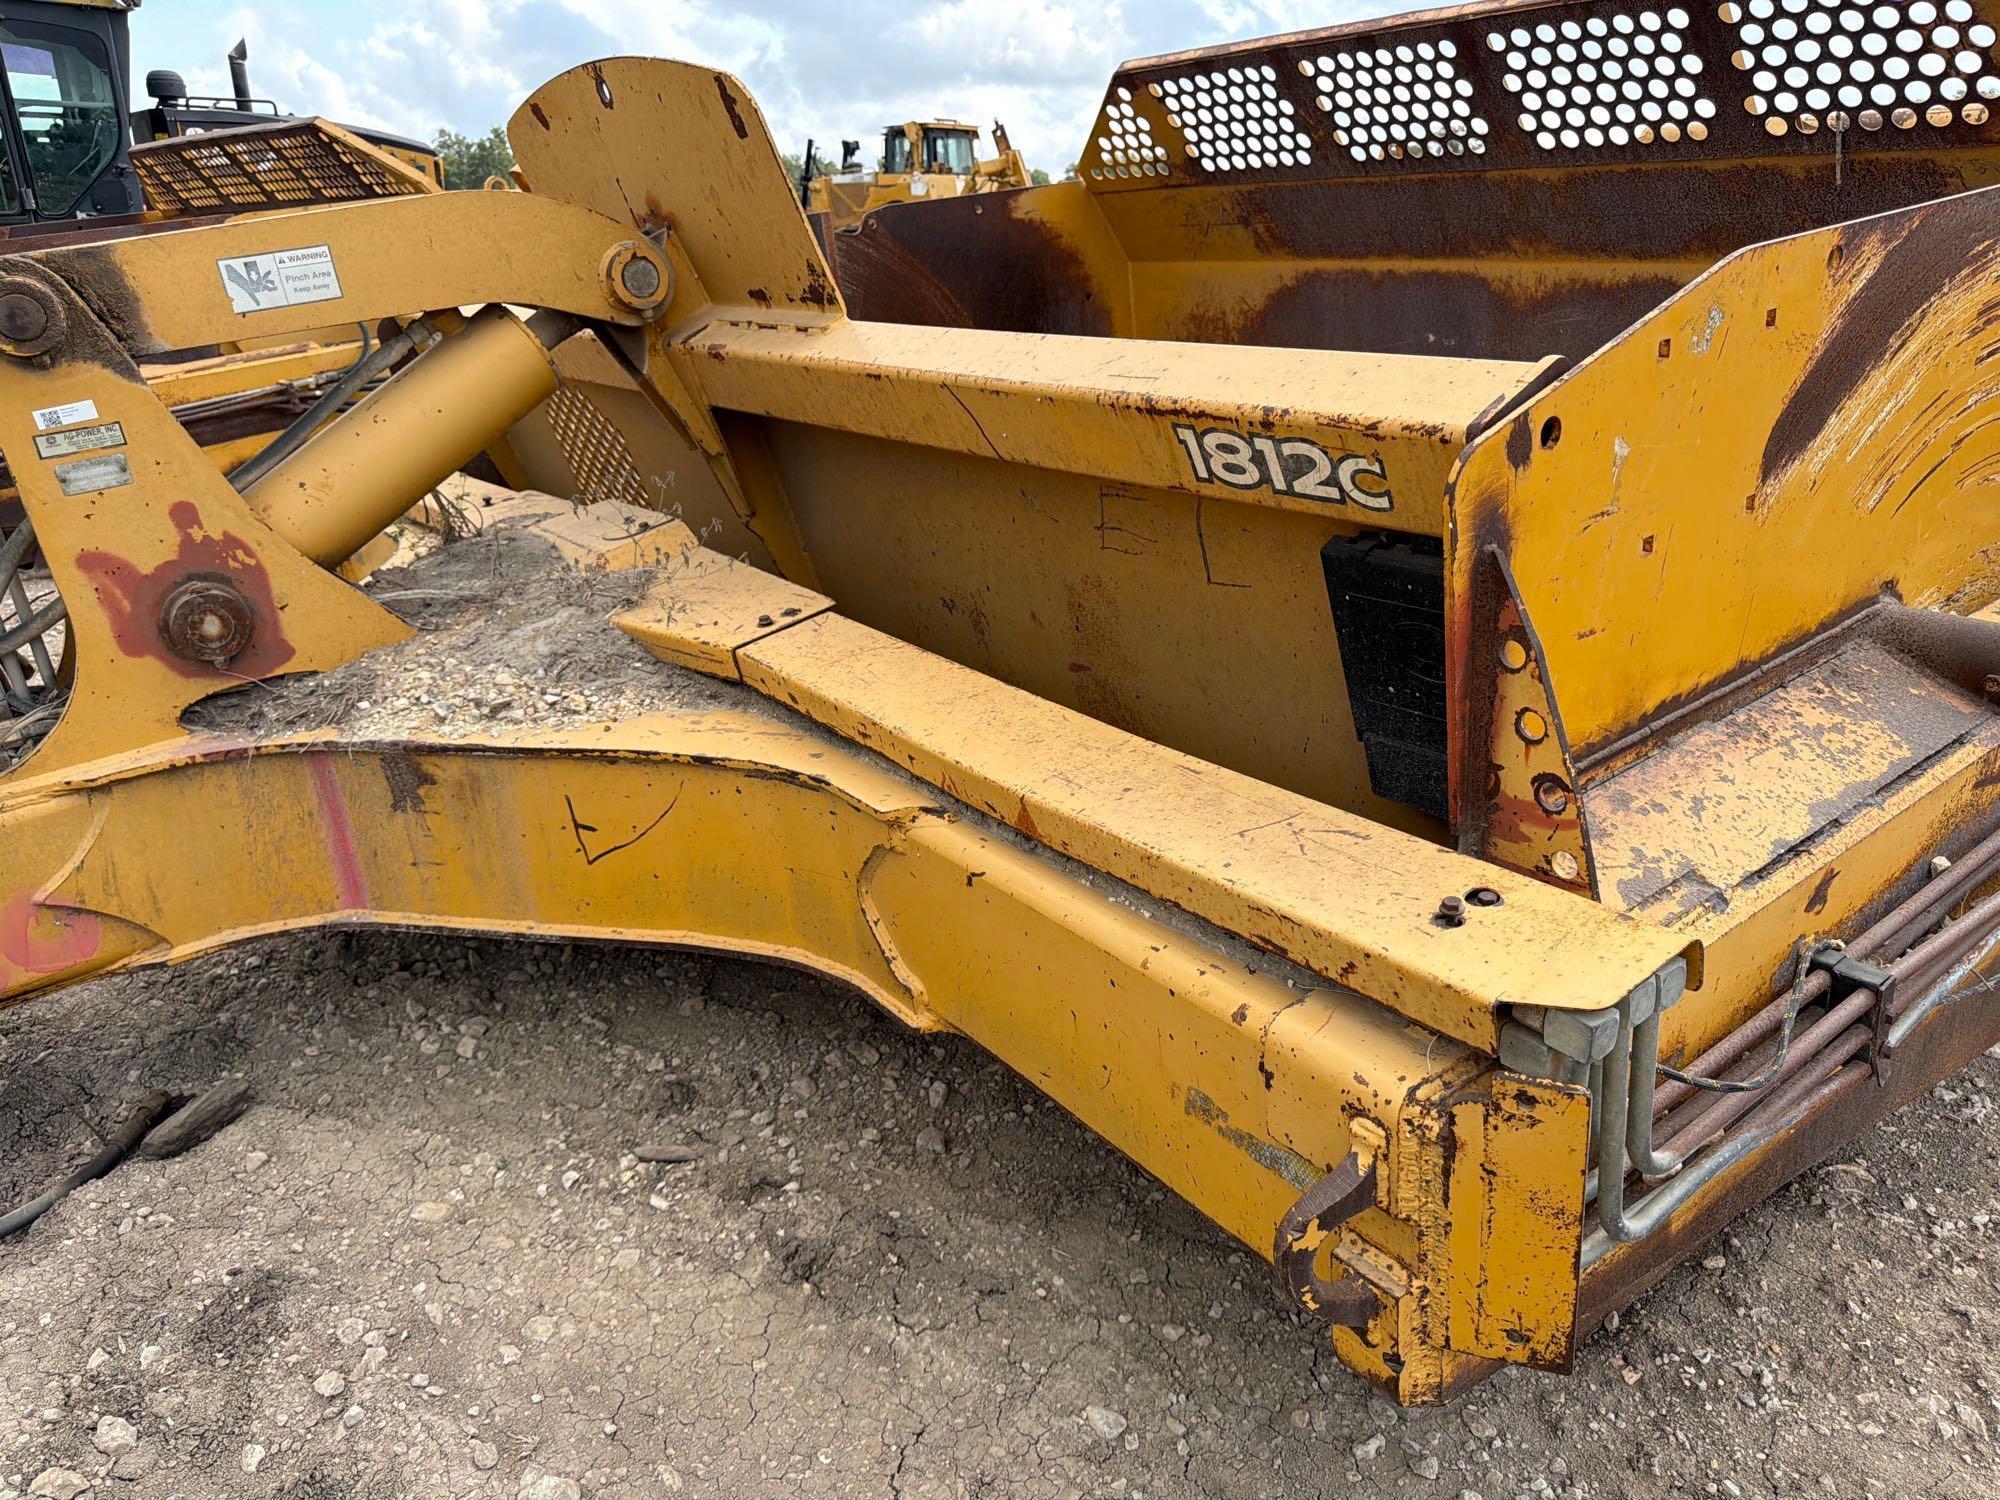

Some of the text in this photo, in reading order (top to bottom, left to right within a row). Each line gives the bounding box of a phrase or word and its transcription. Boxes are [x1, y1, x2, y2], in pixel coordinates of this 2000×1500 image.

[288, 251, 328, 263] WARNING
[285, 270, 332, 283] Pinch Area
[312, 283, 330, 291] Away
[1172, 422, 1394, 512] 1812C
